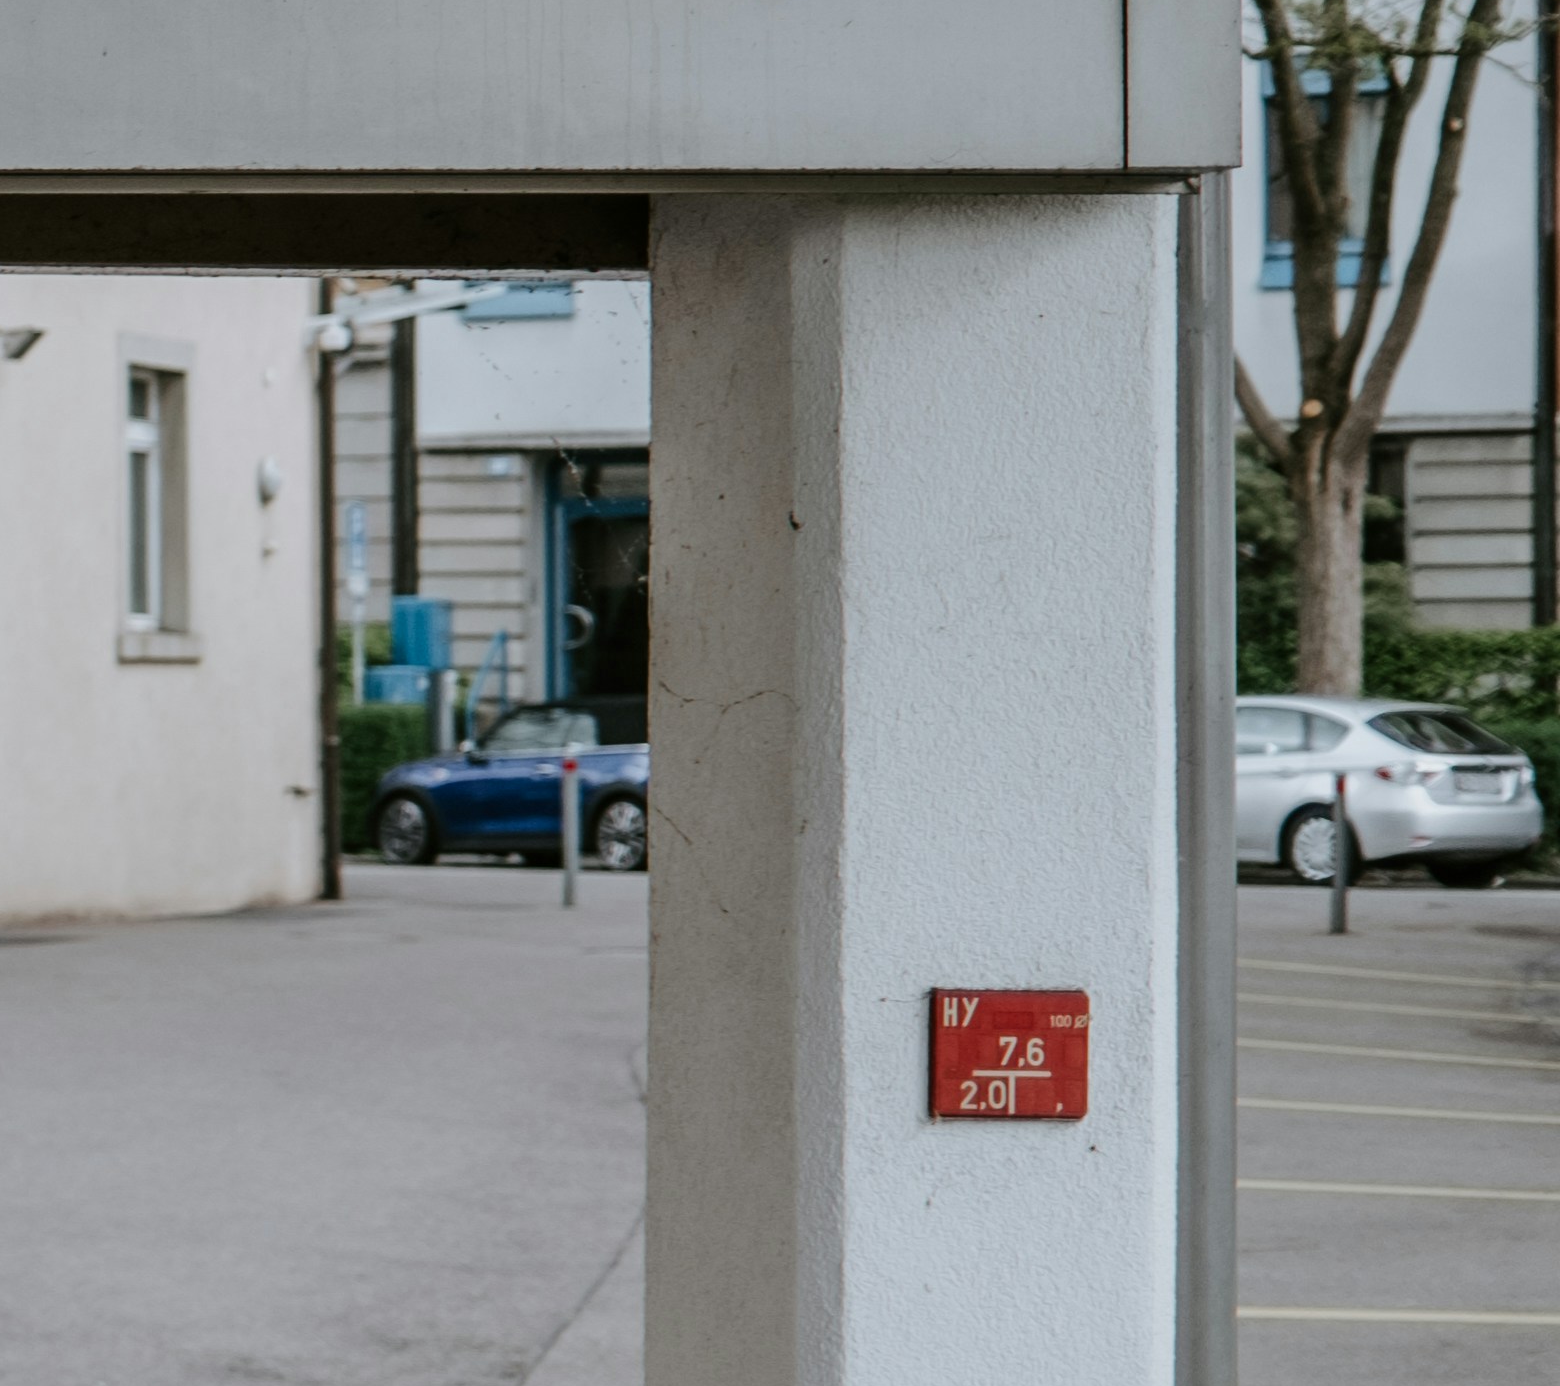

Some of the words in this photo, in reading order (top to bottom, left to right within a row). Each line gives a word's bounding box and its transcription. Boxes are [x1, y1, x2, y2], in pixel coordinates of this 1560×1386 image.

[942, 996, 980, 1028] HY
[1050, 1014, 1073, 1029] 100
[998, 1035, 1046, 1068] 7,6
[959, 1079, 1008, 1112] 2,0
